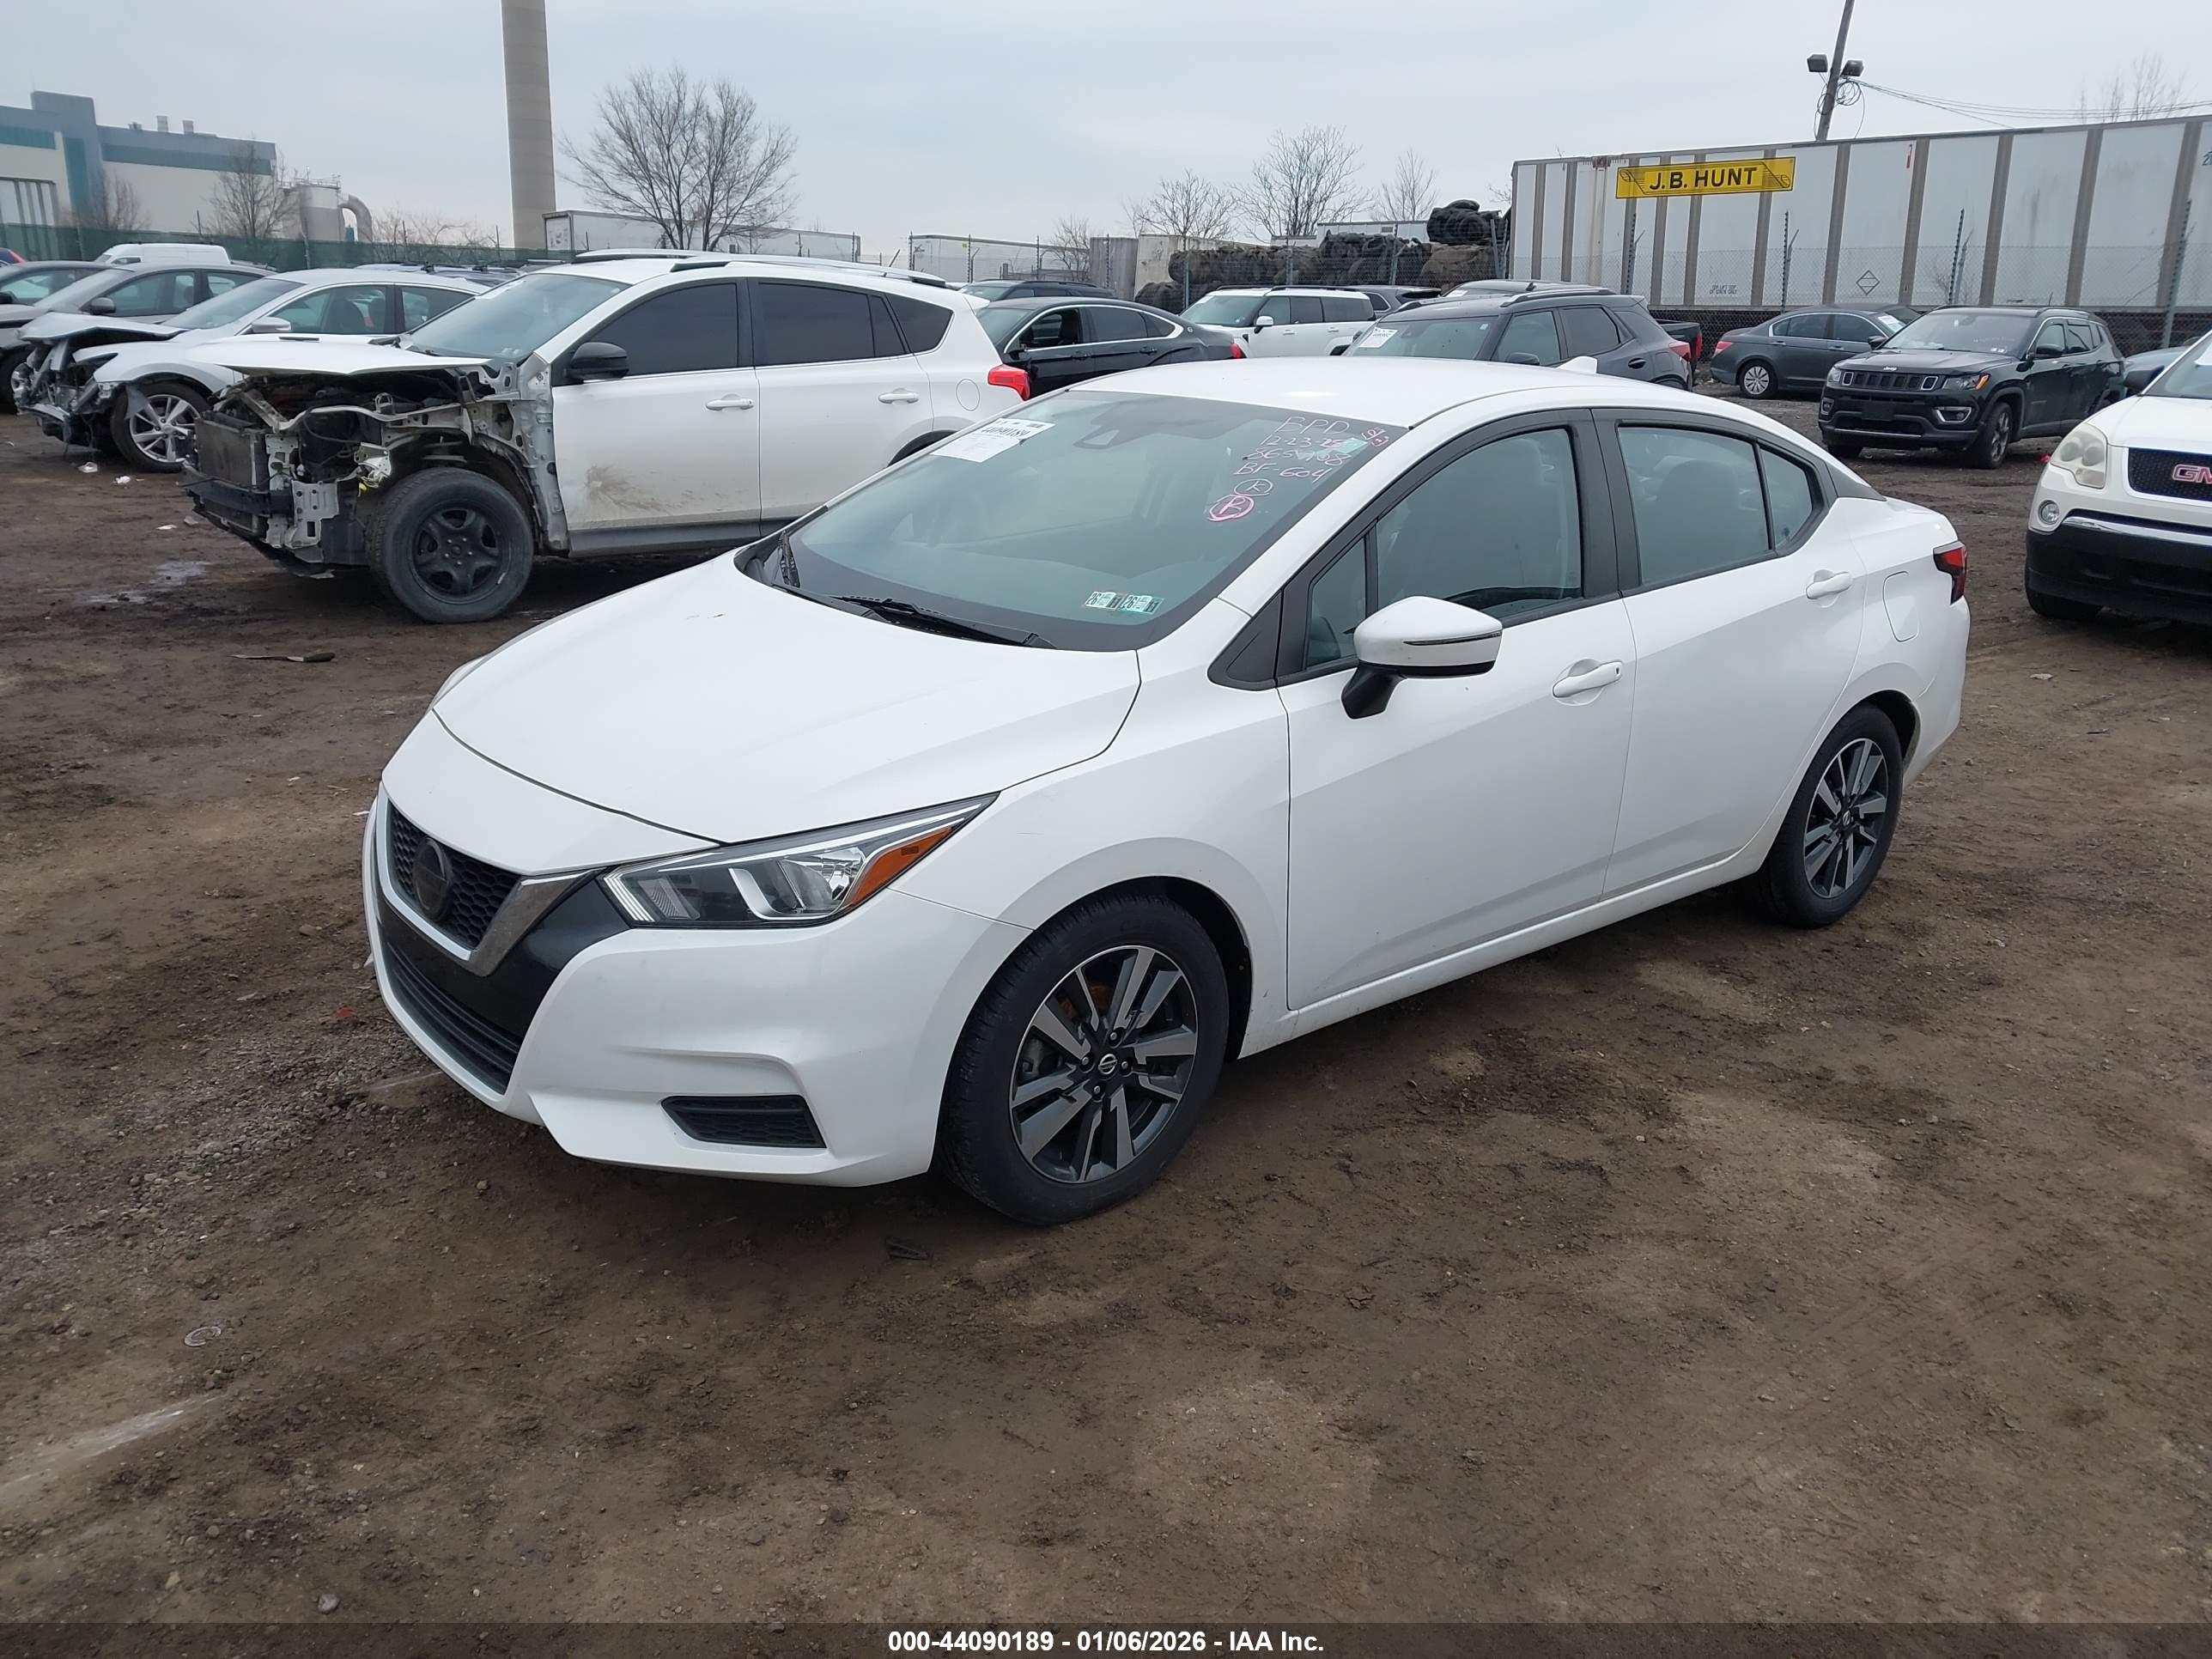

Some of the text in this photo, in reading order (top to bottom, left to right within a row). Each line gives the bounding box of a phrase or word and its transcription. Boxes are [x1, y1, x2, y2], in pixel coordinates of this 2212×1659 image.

[1649, 167, 1758, 191] J.B. HUNT
[1274, 416, 1351, 435] BPD
[2172, 465, 2212, 483] GM
